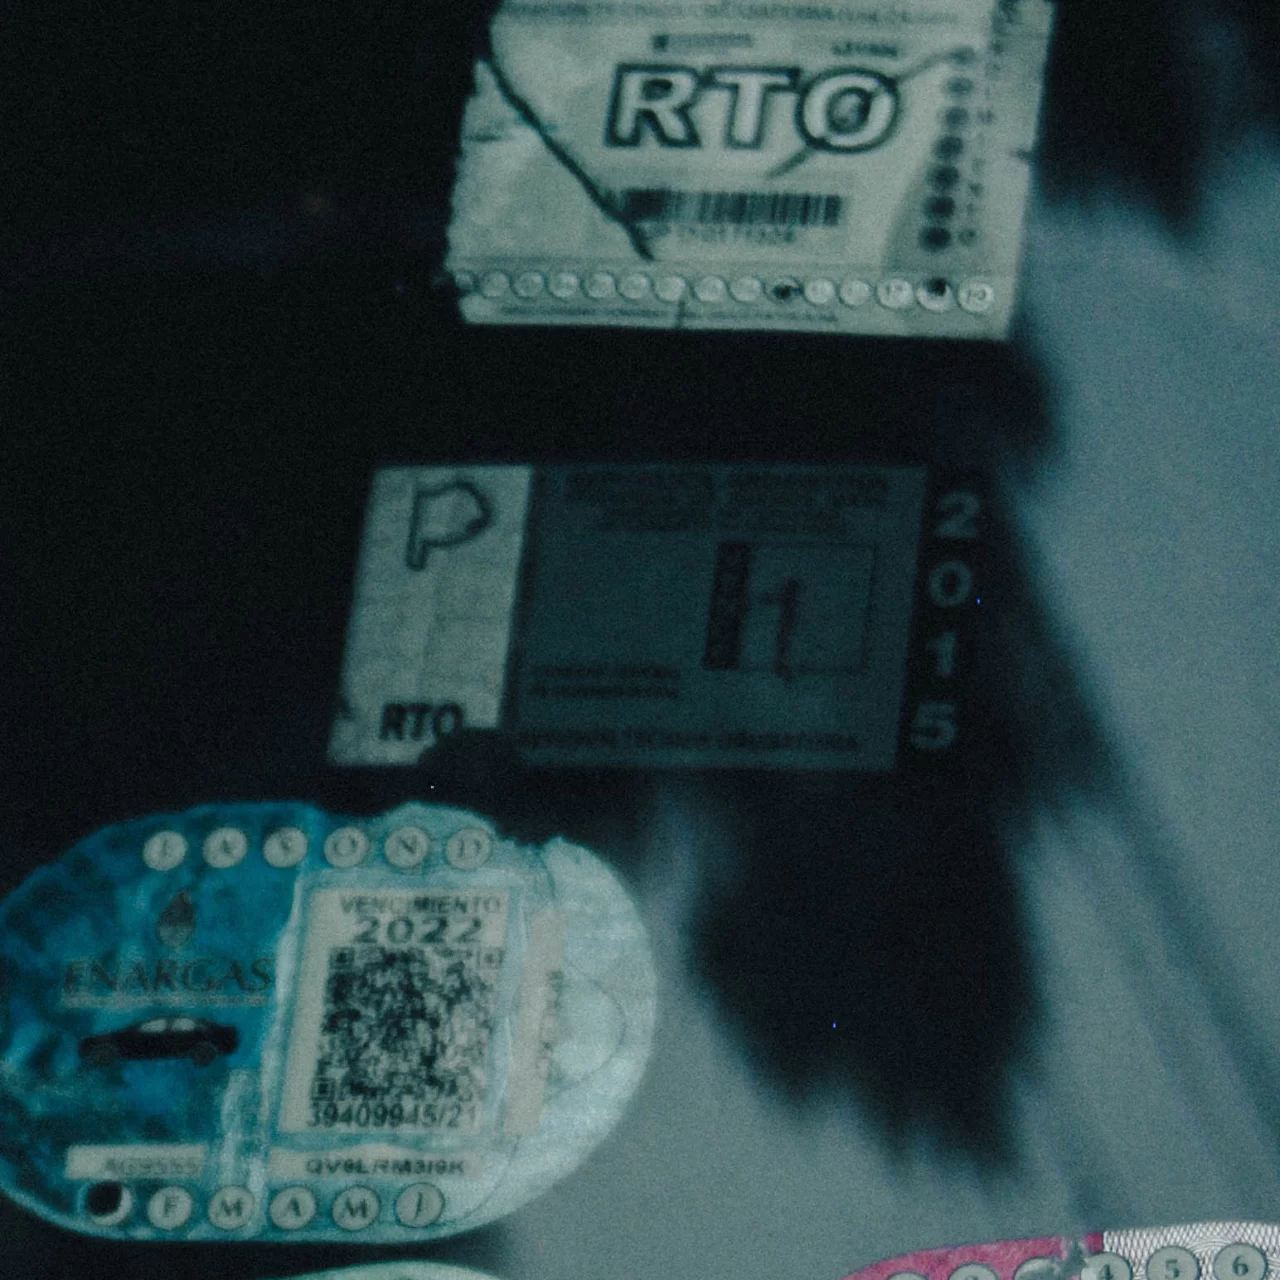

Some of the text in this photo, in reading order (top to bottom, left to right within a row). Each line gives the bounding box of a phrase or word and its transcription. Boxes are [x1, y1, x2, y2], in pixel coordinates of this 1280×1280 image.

[605, 62, 902, 154] RTO
[406, 481, 494, 571] P
[381, 702, 462, 740] RTO
[353, 916, 482, 944] 2022
[344, 1197, 369, 1219] M
[1165, 1259, 1180, 1280] 5
[1233, 1255, 1250, 1277] 6
